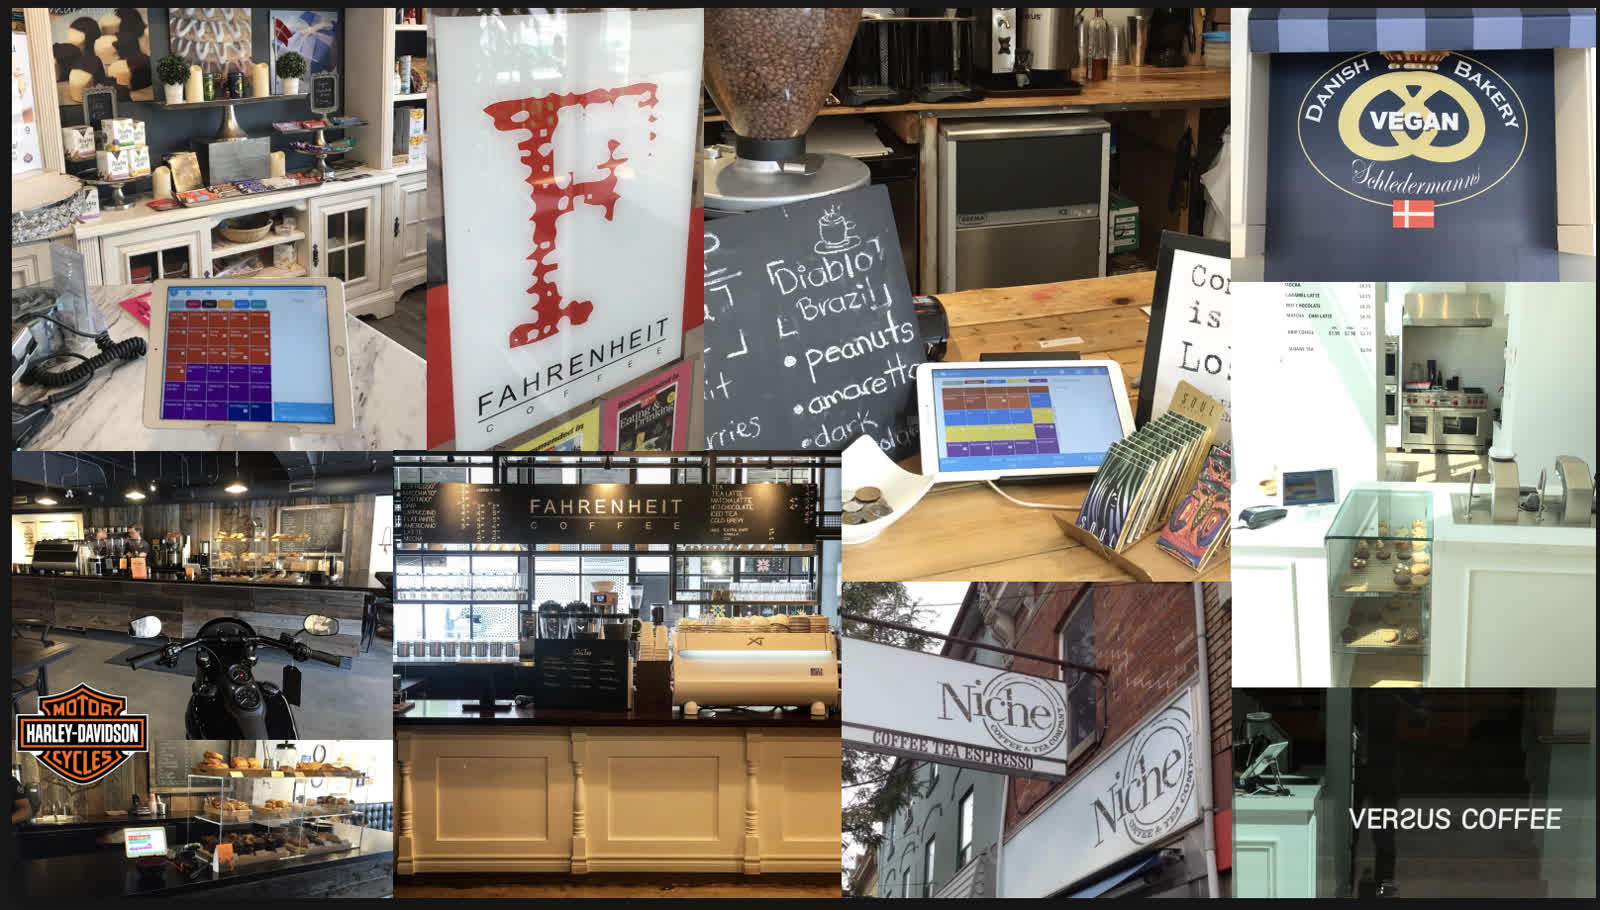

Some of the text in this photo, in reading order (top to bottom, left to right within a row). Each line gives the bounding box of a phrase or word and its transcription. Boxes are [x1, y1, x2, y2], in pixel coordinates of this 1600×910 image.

[1305, 59, 1519, 129] DANISH BAKERY
[1370, 111, 1460, 131] VEGAN
[774, 251, 873, 295] Diablo
[796, 276, 876, 321] Brazil
[1189, 300, 1221, 328] is
[478, 317, 669, 417] FAHRENHEIT
[805, 311, 914, 384] peanuts
[485, 347, 663, 433] COFFEE
[1182, 392, 1215, 417] SOUL
[815, 411, 878, 448] dark
[530, 499, 682, 514] FAHRENHEIT
[531, 521, 681, 531] COFFEE
[937, 680, 1053, 730] Niche
[873, 731, 1034, 770] COFFEE TEA ESPRESSO
[1089, 749, 1183, 849] Niche
